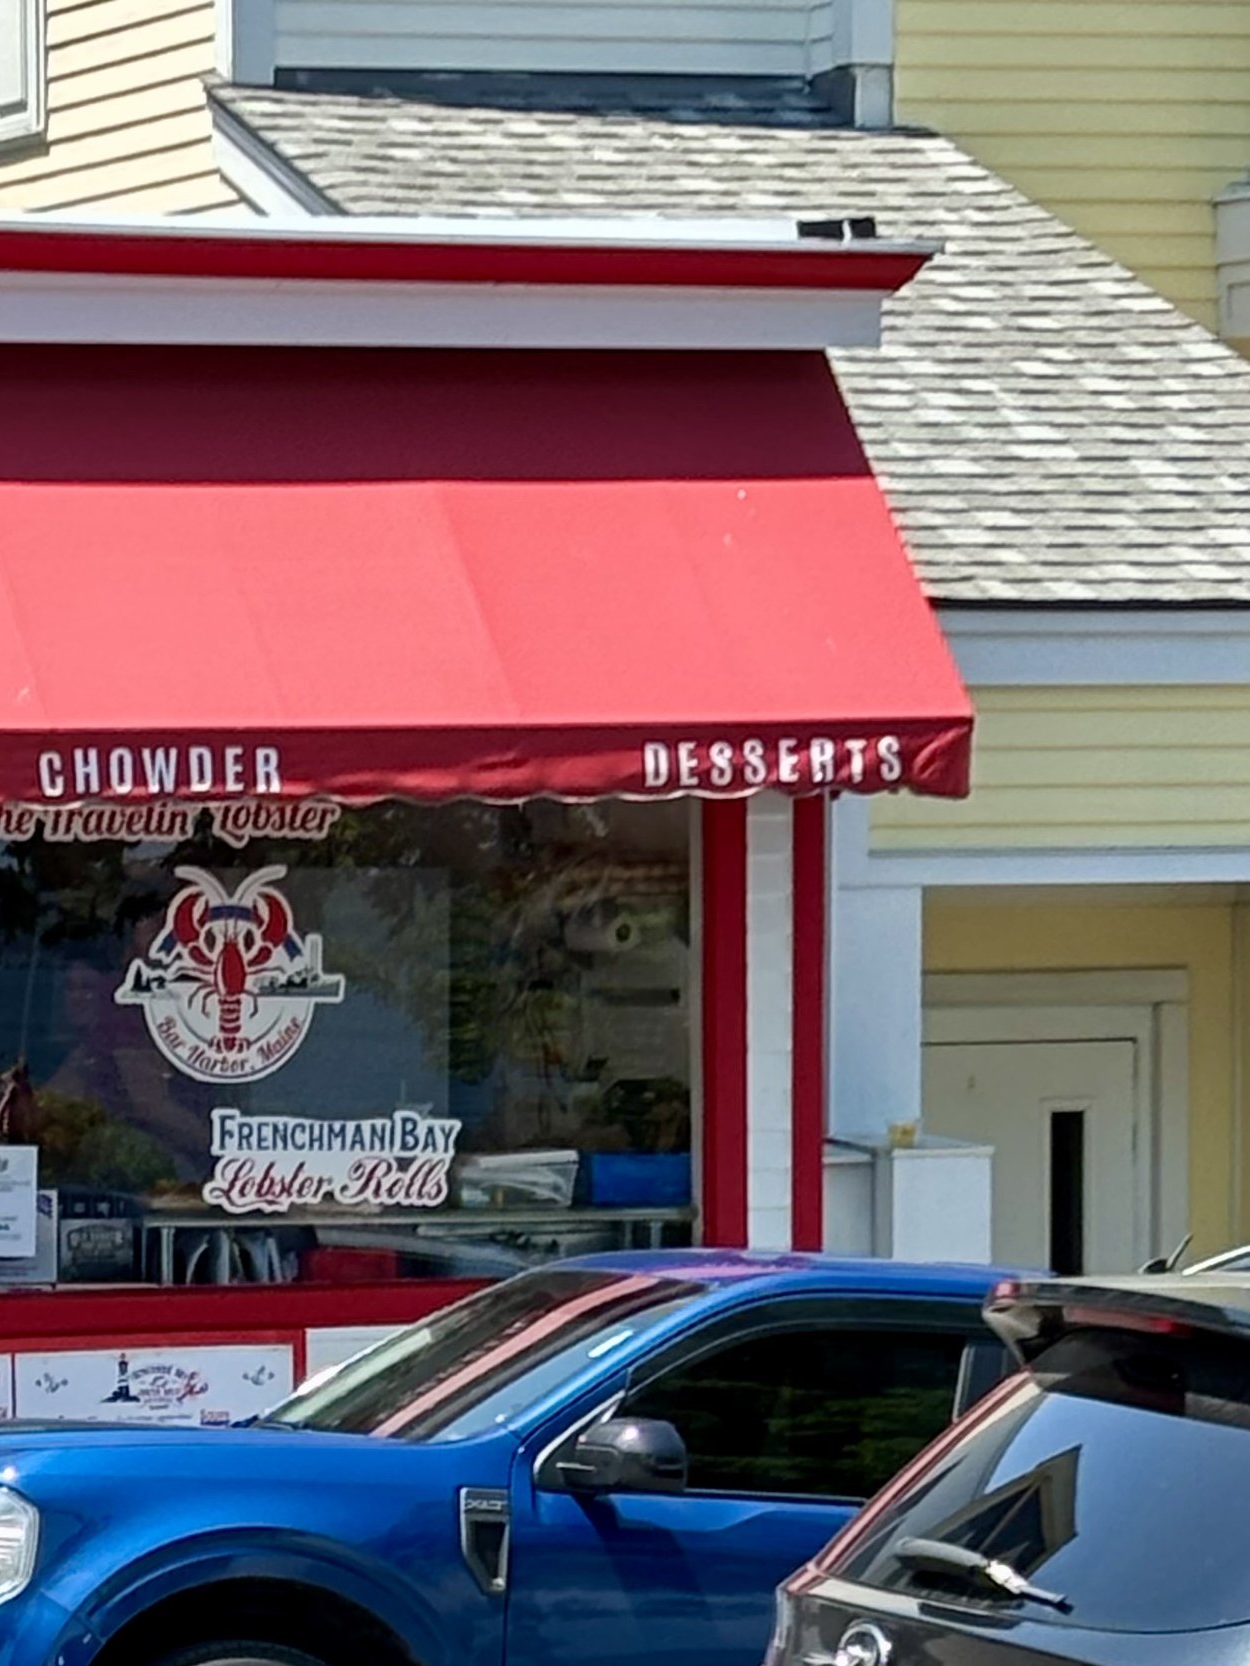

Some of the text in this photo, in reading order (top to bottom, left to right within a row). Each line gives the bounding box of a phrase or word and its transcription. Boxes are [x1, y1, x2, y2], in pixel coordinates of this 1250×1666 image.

[38, 745, 282, 797] CHOWDER
[642, 735, 902, 788] DESSERTS
[217, 801, 338, 843] Lobster
[156, 1015, 186, 1050] Bar
[256, 1016, 302, 1063] Maine
[217, 1114, 457, 1153] FRENCHMAN BAY
[208, 1156, 447, 1205] Lobster Rolls
